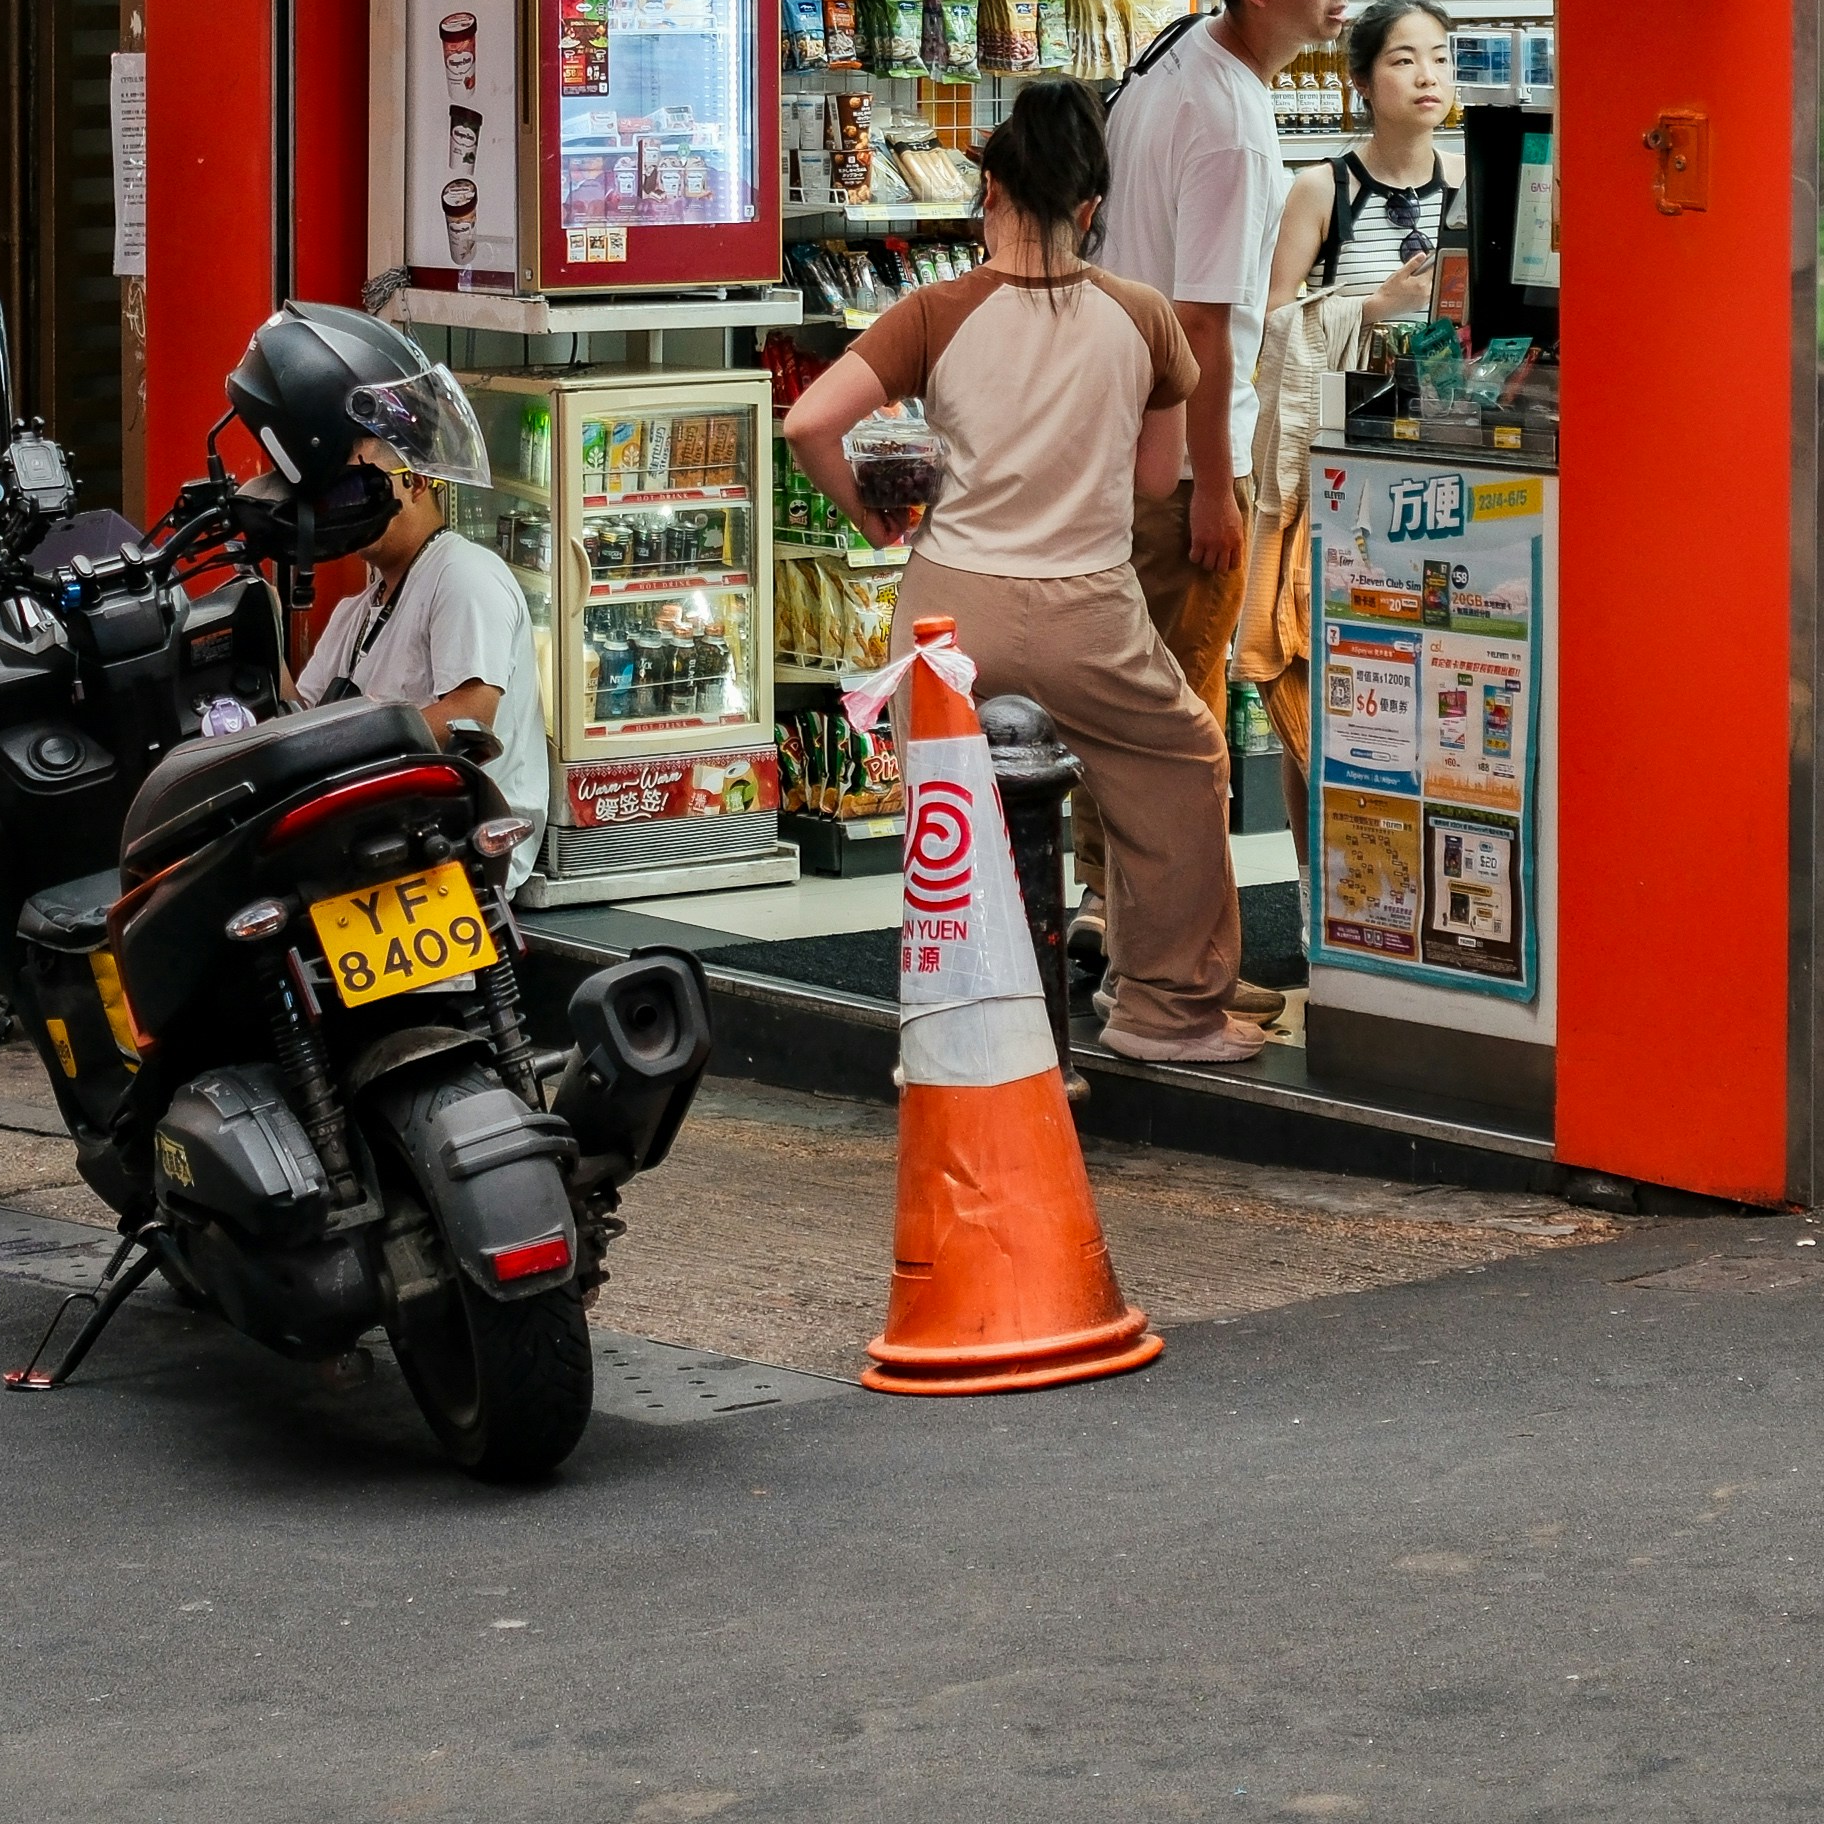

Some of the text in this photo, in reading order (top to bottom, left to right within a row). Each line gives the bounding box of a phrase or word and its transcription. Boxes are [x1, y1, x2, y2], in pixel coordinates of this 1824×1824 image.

[1389, 475, 1464, 541] 方便
[1406, 580, 1422, 591] Sim
[350, 878, 429, 935] YF
[916, 919, 968, 942] YUEN
[338, 916, 483, 992] 8409
